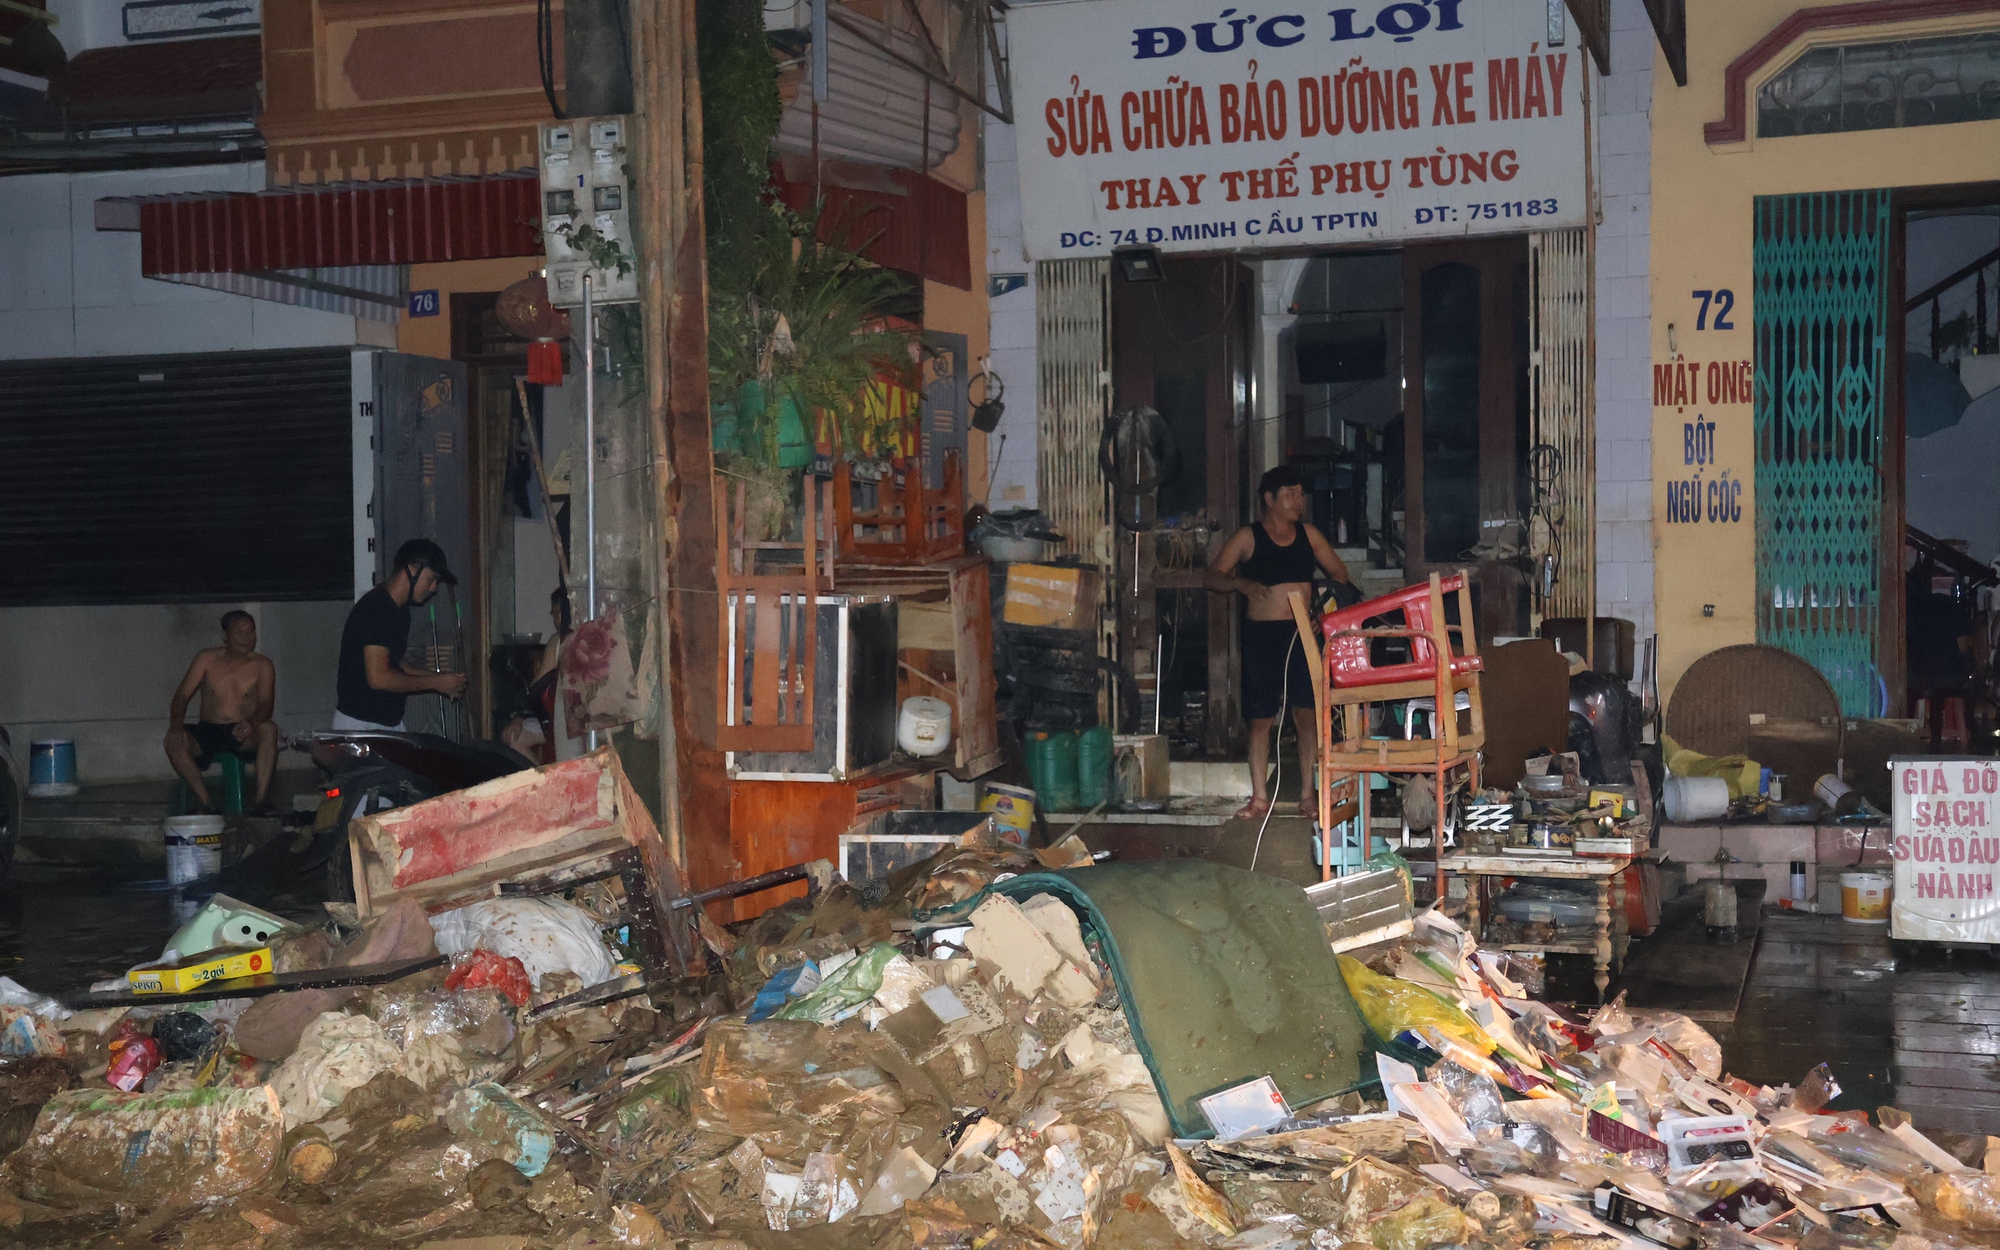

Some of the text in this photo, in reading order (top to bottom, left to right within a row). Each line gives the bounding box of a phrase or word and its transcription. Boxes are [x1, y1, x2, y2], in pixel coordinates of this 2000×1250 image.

[1131, 0, 1464, 59] ĐỨC LỢI
[1045, 41, 1568, 158] SỬA CHỮA BẢO DƯỠNG XE MÁY
[1100, 146, 1520, 211] THAY THẾ PHỤ TÙNG
[1060, 230, 1102, 249] ĐC:
[1109, 229, 1138, 245] 74
[1312, 211, 1378, 231] TPTN
[1415, 205, 1458, 225] ĐT:
[1467, 198, 1559, 220] 751183
[414, 293, 434, 312] 76
[1691, 289, 1735, 331] 72
[1653, 353, 1752, 414] MẬT ONG
[1683, 413, 1716, 472] BỘT
[1666, 467, 1742, 523] NGŨ CỐC
[1902, 761, 1949, 795] GIÁ
[1915, 800, 1985, 833] SẠCH
[1917, 866, 1993, 899] NÀNH
[132, 980, 163, 993] Custas
